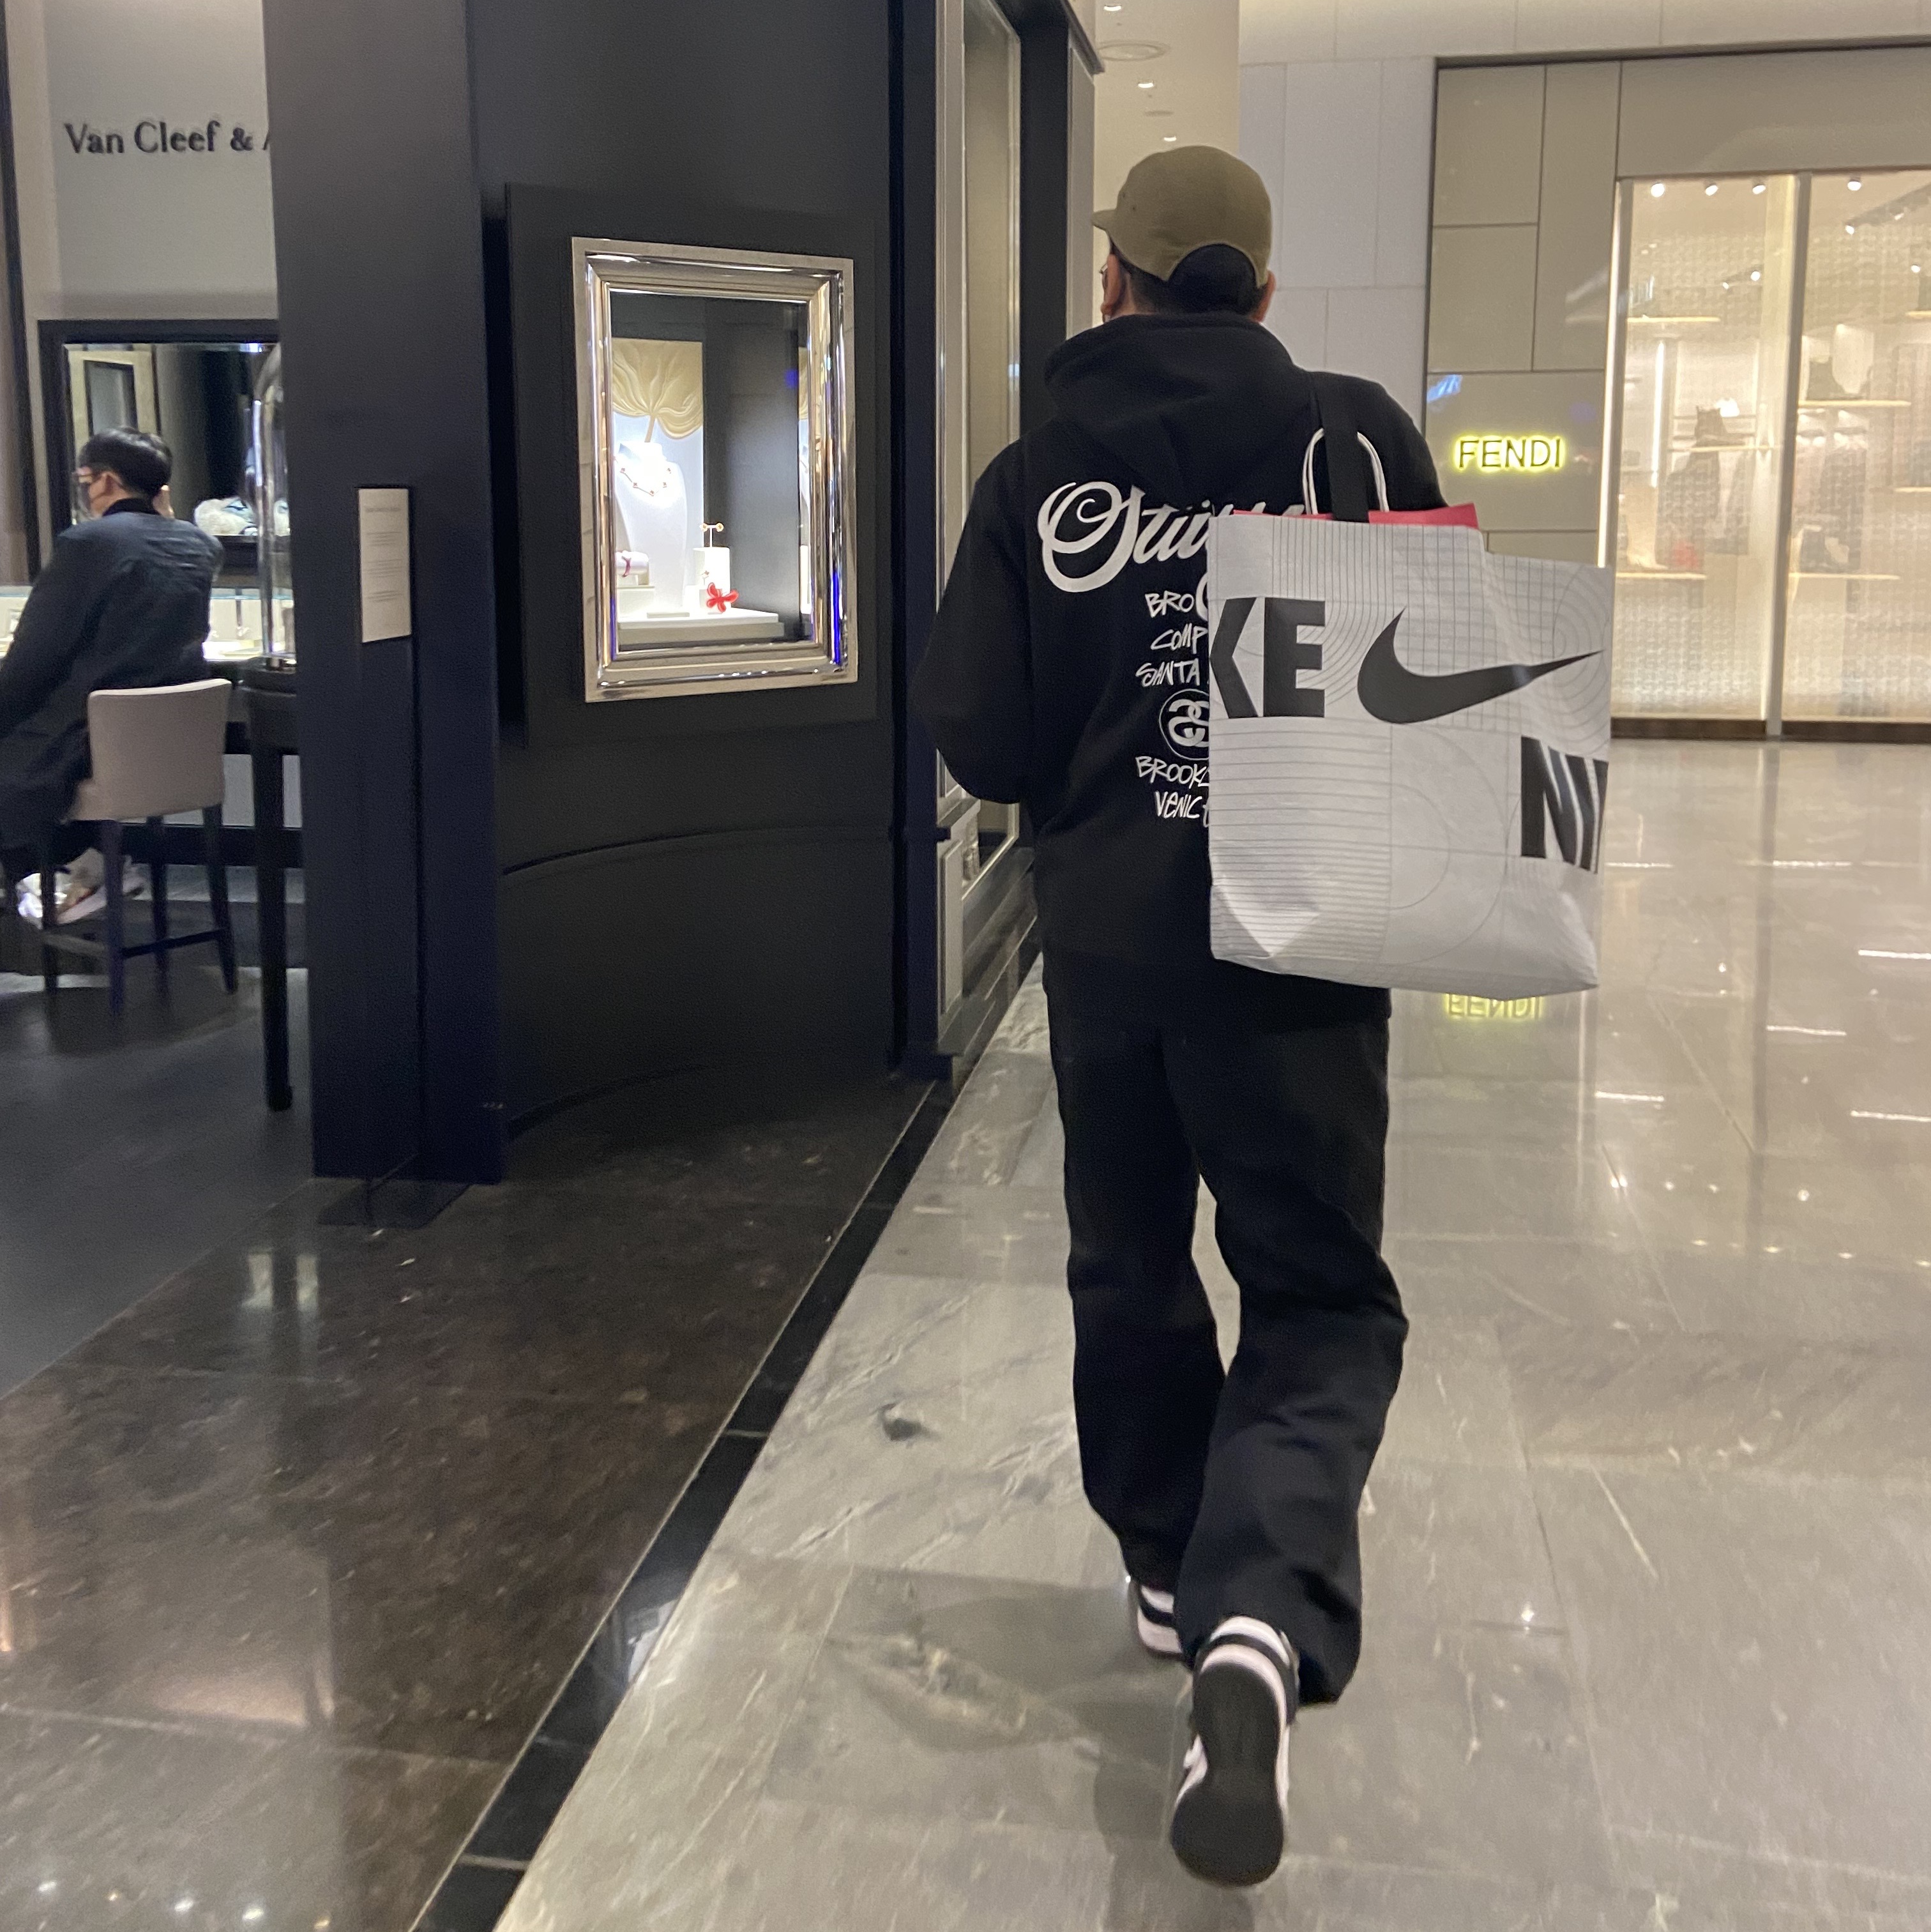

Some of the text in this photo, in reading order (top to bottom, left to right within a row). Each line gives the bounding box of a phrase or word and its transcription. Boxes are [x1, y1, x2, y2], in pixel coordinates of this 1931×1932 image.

[64, 123, 125, 153] Van
[134, 120, 220, 153] Cleef
[230, 128, 253, 151] &
[1459, 439, 1561, 468] FENDI
[1135, 658, 1200, 687] SANTA
